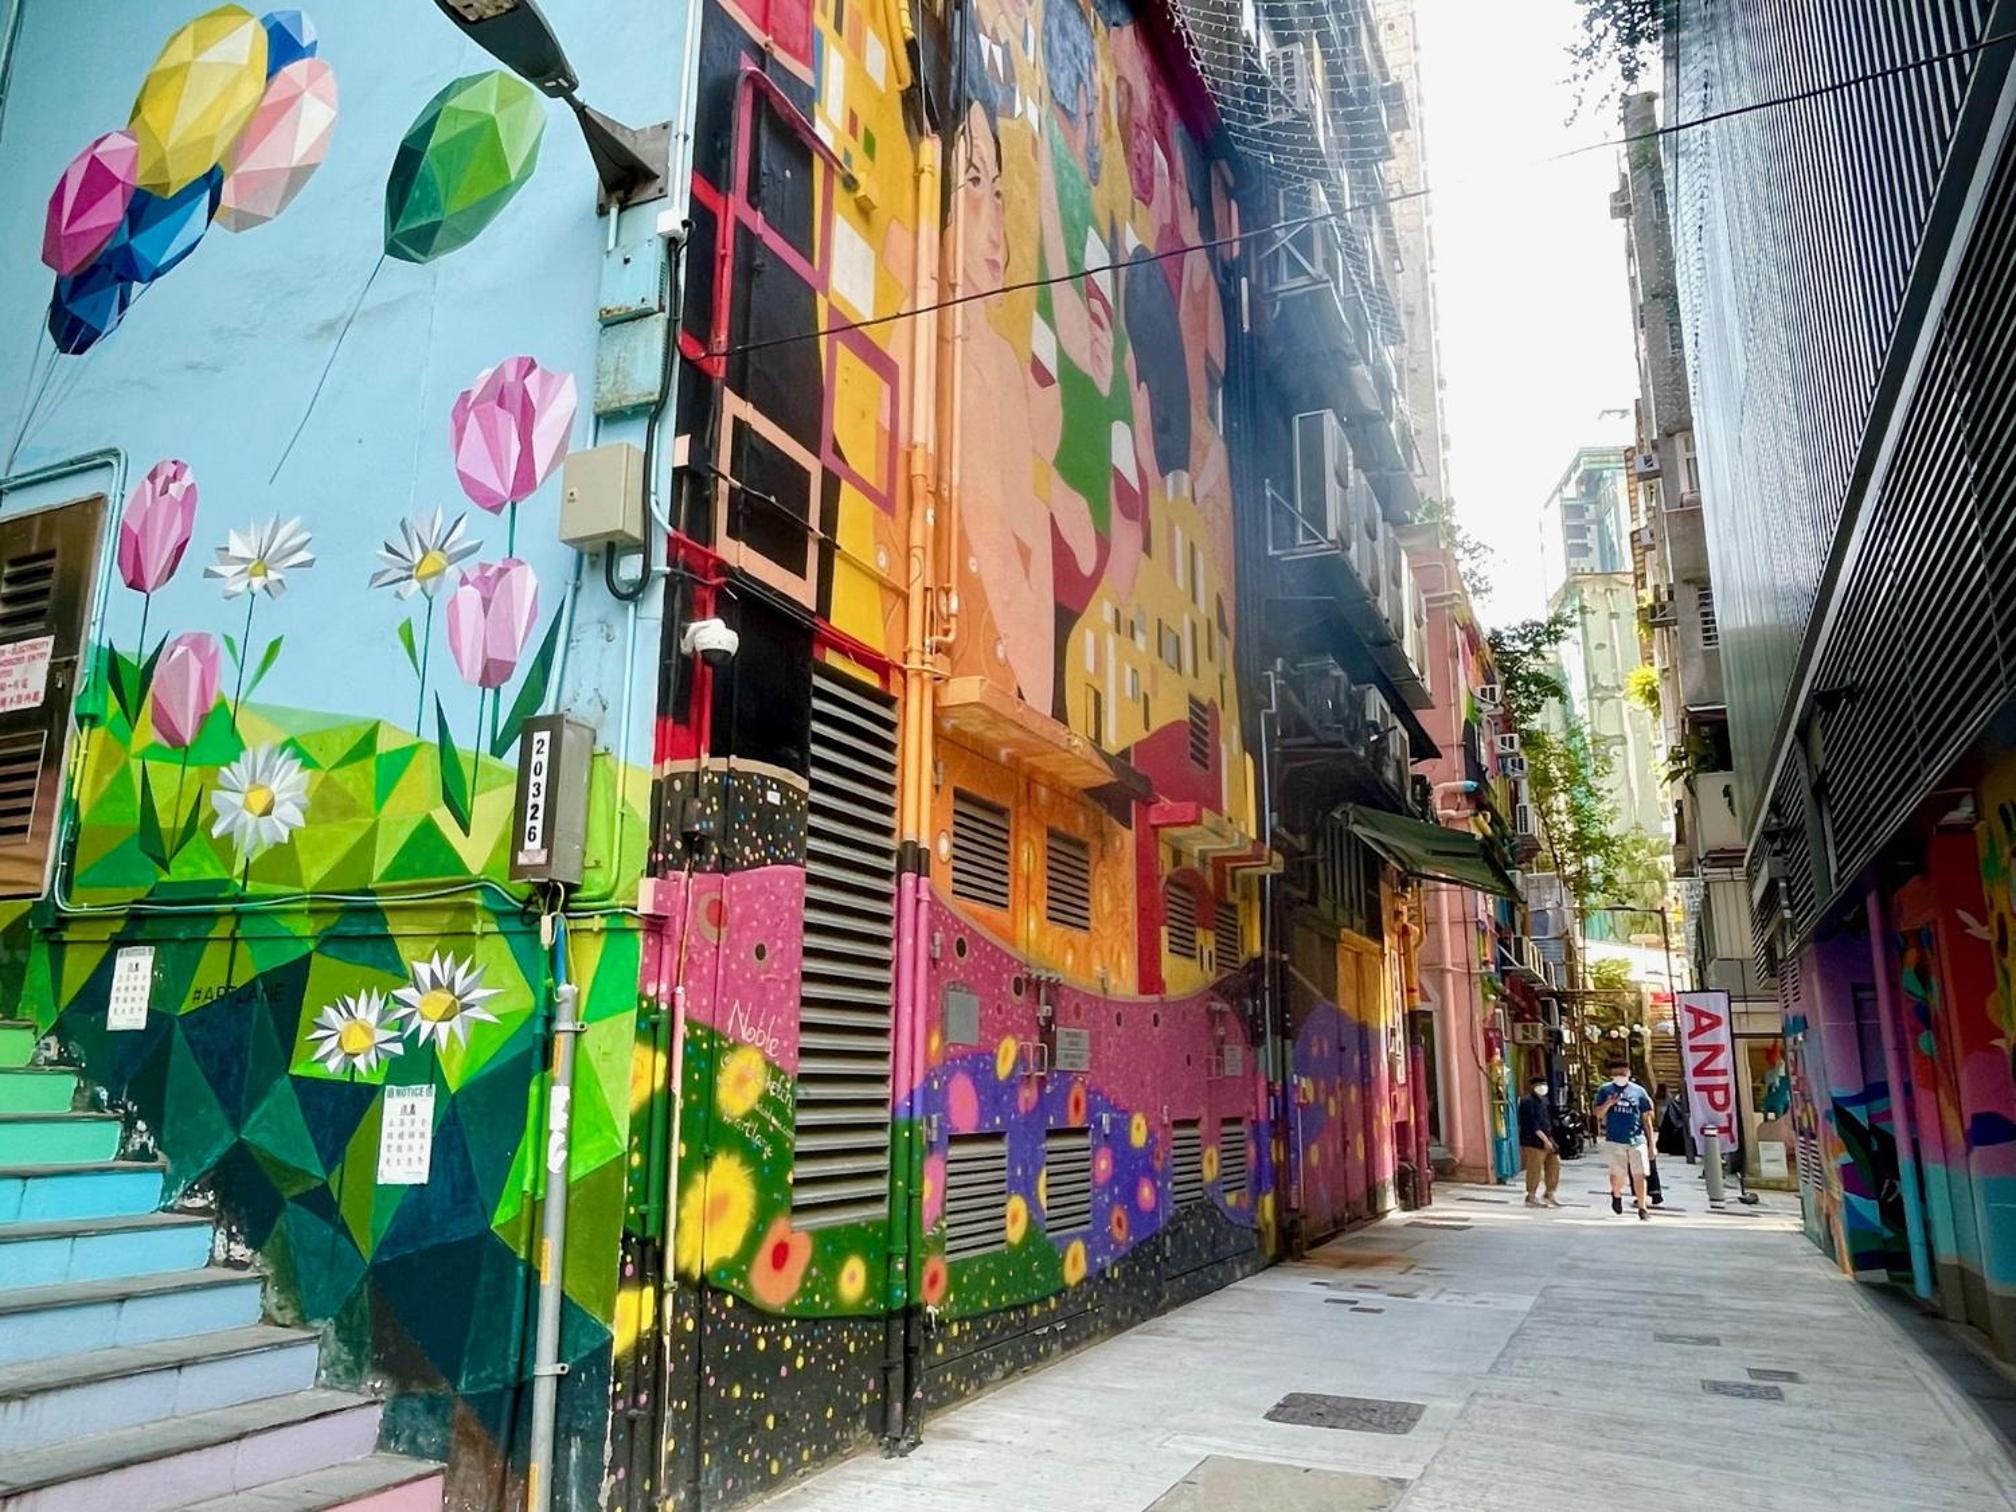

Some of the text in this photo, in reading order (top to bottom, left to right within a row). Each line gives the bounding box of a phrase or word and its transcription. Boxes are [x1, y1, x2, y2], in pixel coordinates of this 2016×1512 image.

[527, 738, 545, 842] 20326
[727, 999, 780, 1058] Noble
[396, 1086, 425, 1098] NOTICE
[1685, 1004, 1736, 1144] ANPT
